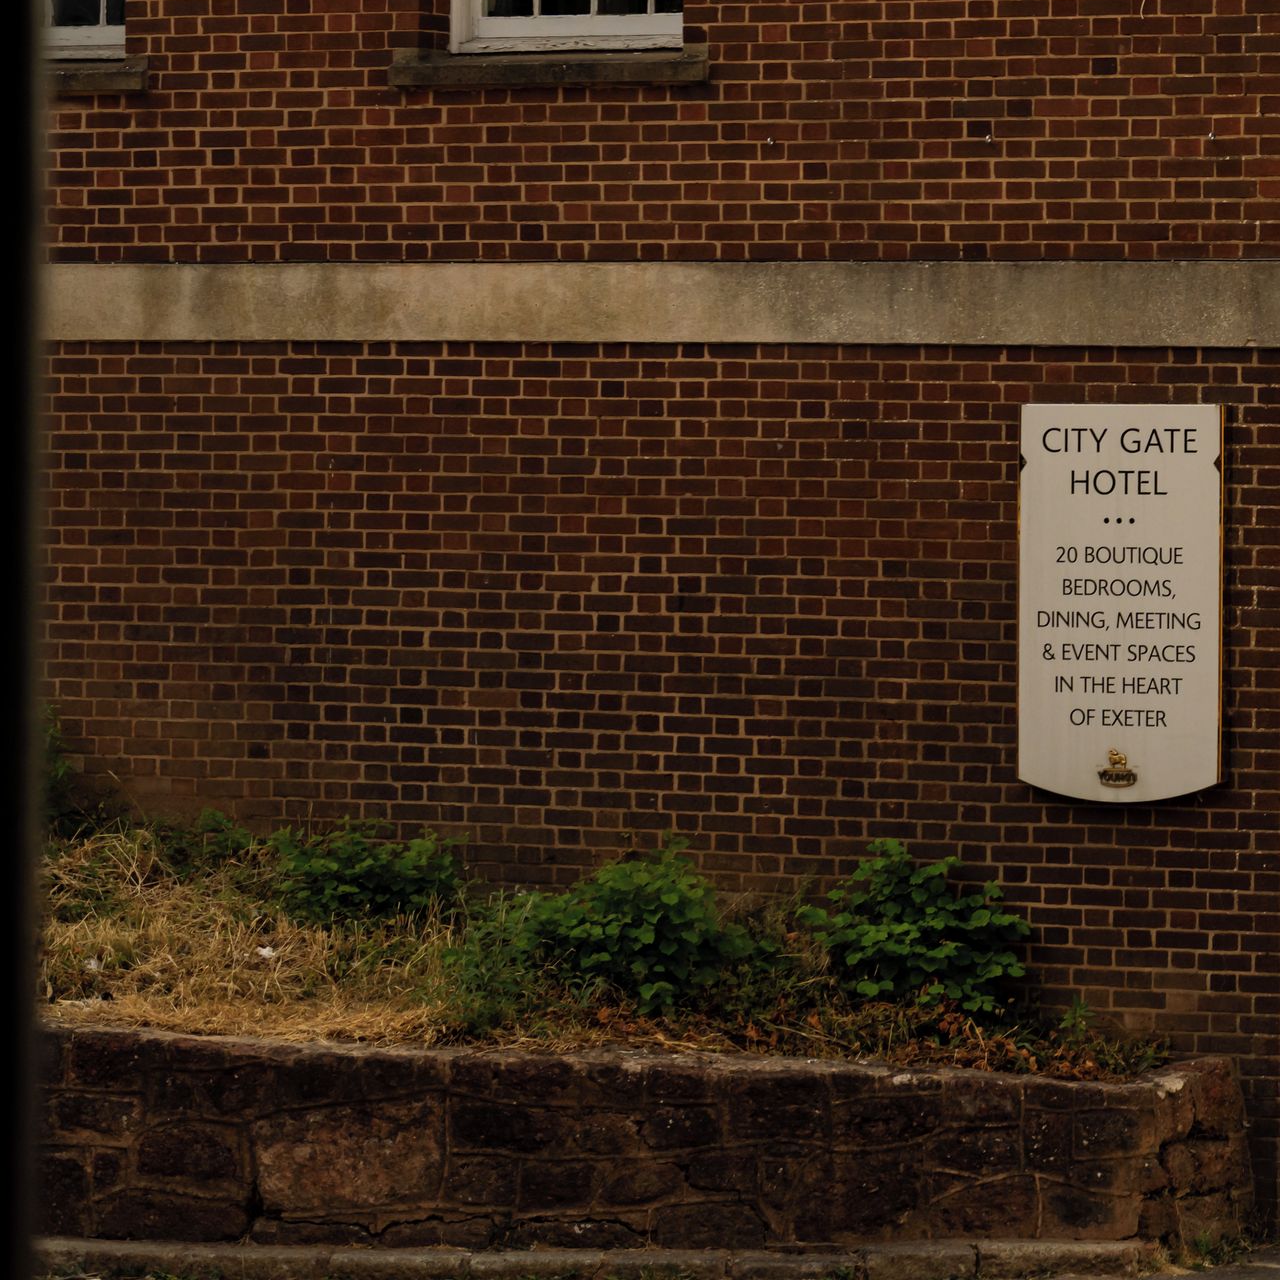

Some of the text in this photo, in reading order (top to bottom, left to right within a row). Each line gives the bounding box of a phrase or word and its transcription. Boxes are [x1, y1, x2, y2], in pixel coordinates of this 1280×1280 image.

[1042, 428, 1198, 453] CITY GATE
[1070, 470, 1168, 495] HOTEL
[1056, 546, 1184, 566] 20 BOUTIQUE
[1062, 579, 1176, 599] BEDROOMS,
[1037, 612, 1201, 632] DINING, MEETING
[1042, 644, 1196, 662] & EVENT SPACES
[1055, 676, 1183, 694] IN THE HEART
[1070, 708, 1167, 727] OF EXETER
